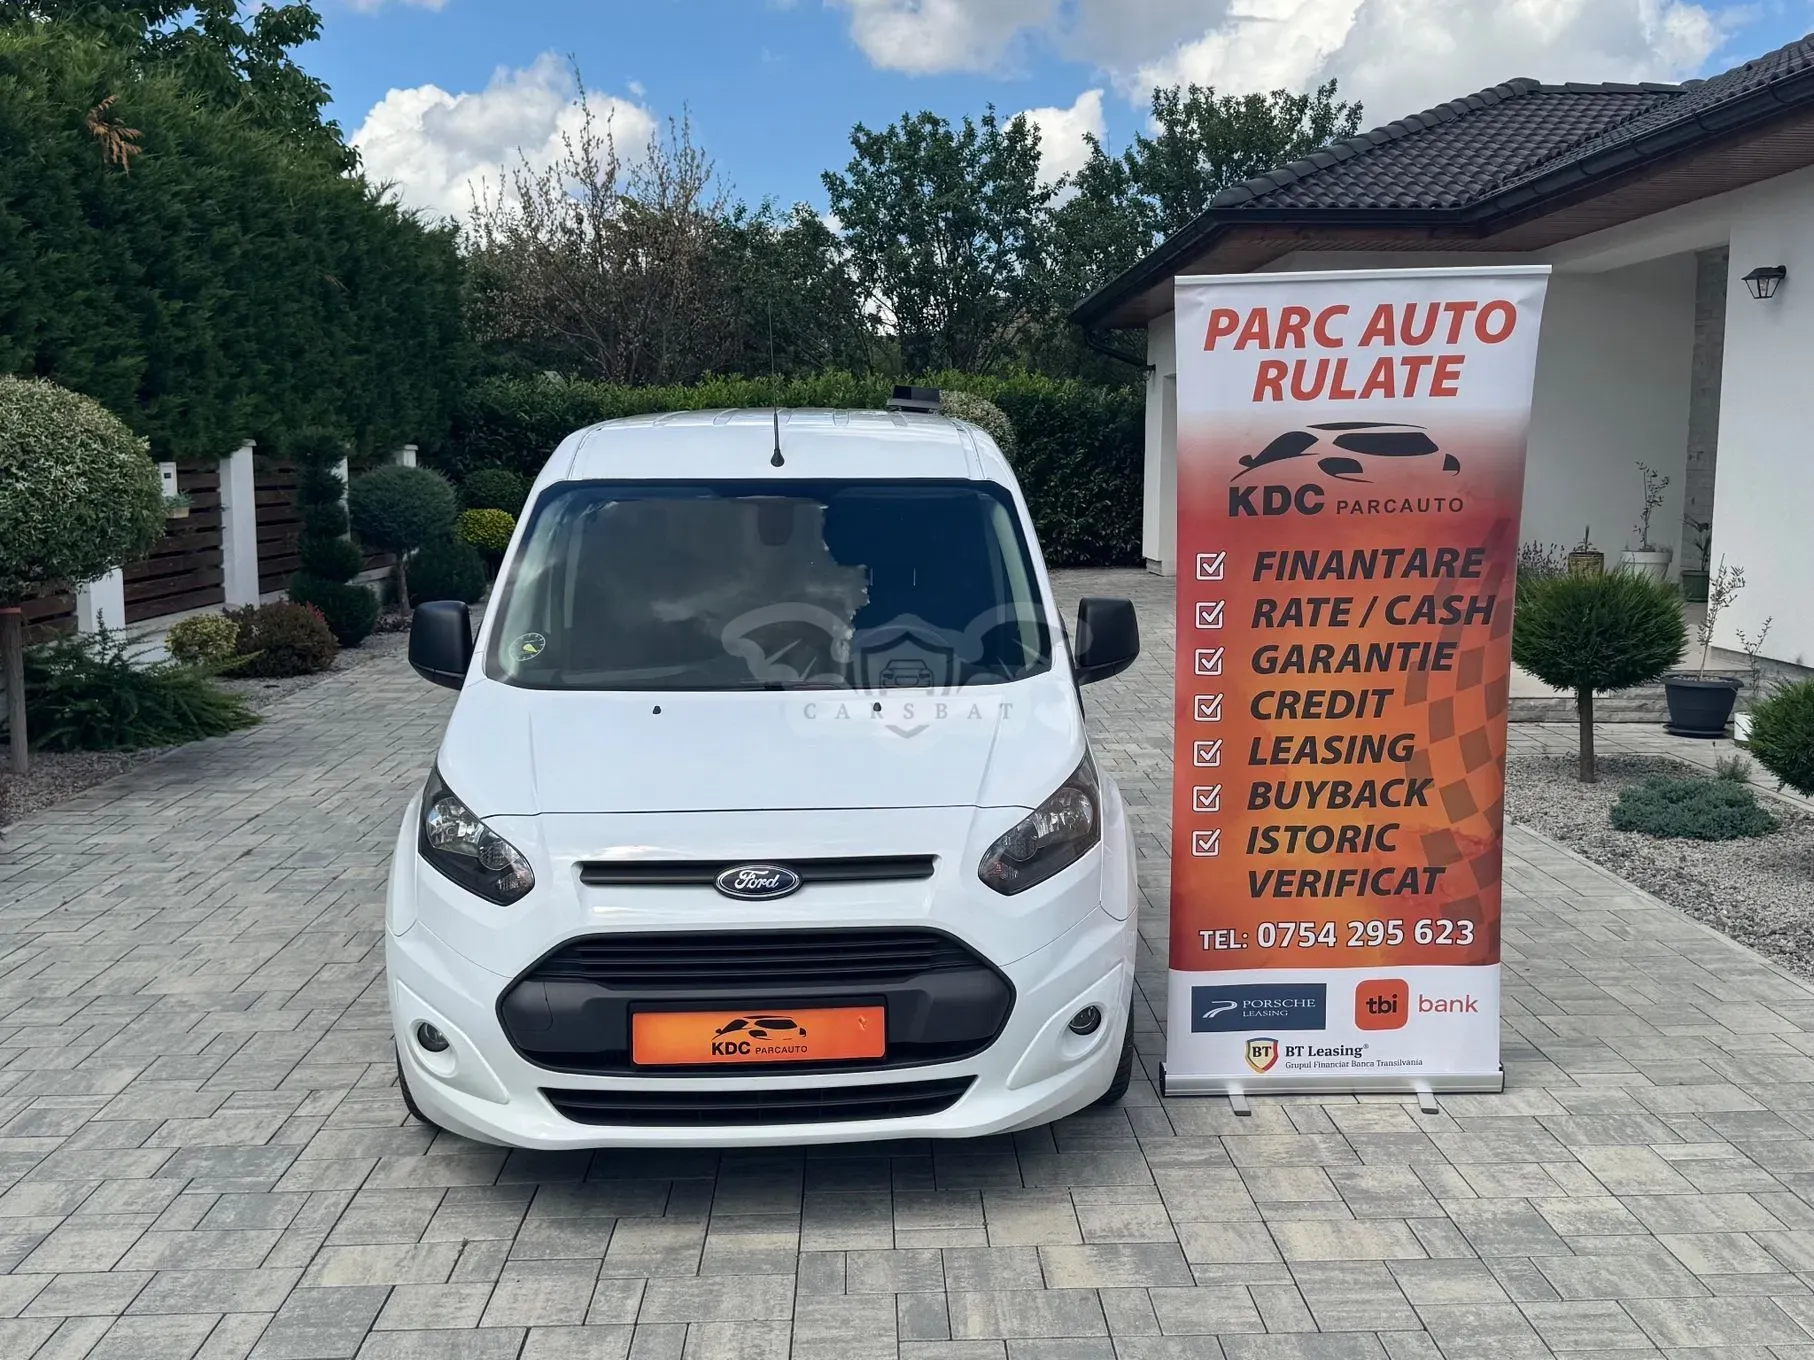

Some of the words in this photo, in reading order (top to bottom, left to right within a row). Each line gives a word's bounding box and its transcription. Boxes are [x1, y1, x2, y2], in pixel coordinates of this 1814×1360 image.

[1203, 304, 1350, 352] PARC
[1358, 299, 1517, 347] AUTO
[1252, 354, 1466, 402] RULATE
[1228, 484, 1325, 517] KDC
[1335, 498, 1464, 515] PARCAUTO
[1252, 547, 1486, 582] FINANTARE
[1251, 596, 1353, 628] RATE
[1385, 594, 1496, 626] CASH
[1251, 641, 1458, 675] GARANTIE
[1249, 688, 1395, 720] CREDIT
[1248, 733, 1416, 766] LEASING
[1247, 778, 1434, 811] BUYBACK
[1245, 823, 1400, 855] ISTORIC
[734, 869, 781, 890] Ford
[1247, 866, 1447, 898] VERIFICAT
[1199, 930, 1248, 950] TEL:
[1257, 921, 1337, 948] 0754
[1347, 920, 1405, 947] 295
[1413, 918, 1475, 946] 623
[1242, 998, 1316, 1008] PORSCHE
[1366, 994, 1398, 1015] tbi
[1418, 994, 1479, 1013] bank
[711, 1041, 751, 1056] KDC
[755, 1045, 808, 1054] PARCAUTO
[1252, 1046, 1272, 1057] BT
[1285, 1046, 1304, 1057] BT
[1285, 1061, 1311, 1069] Grupul
[1313, 1060, 1349, 1068] Financiar
[1351, 1060, 1375, 1068] Banca
[1376, 1059, 1423, 1067] Transilvania
